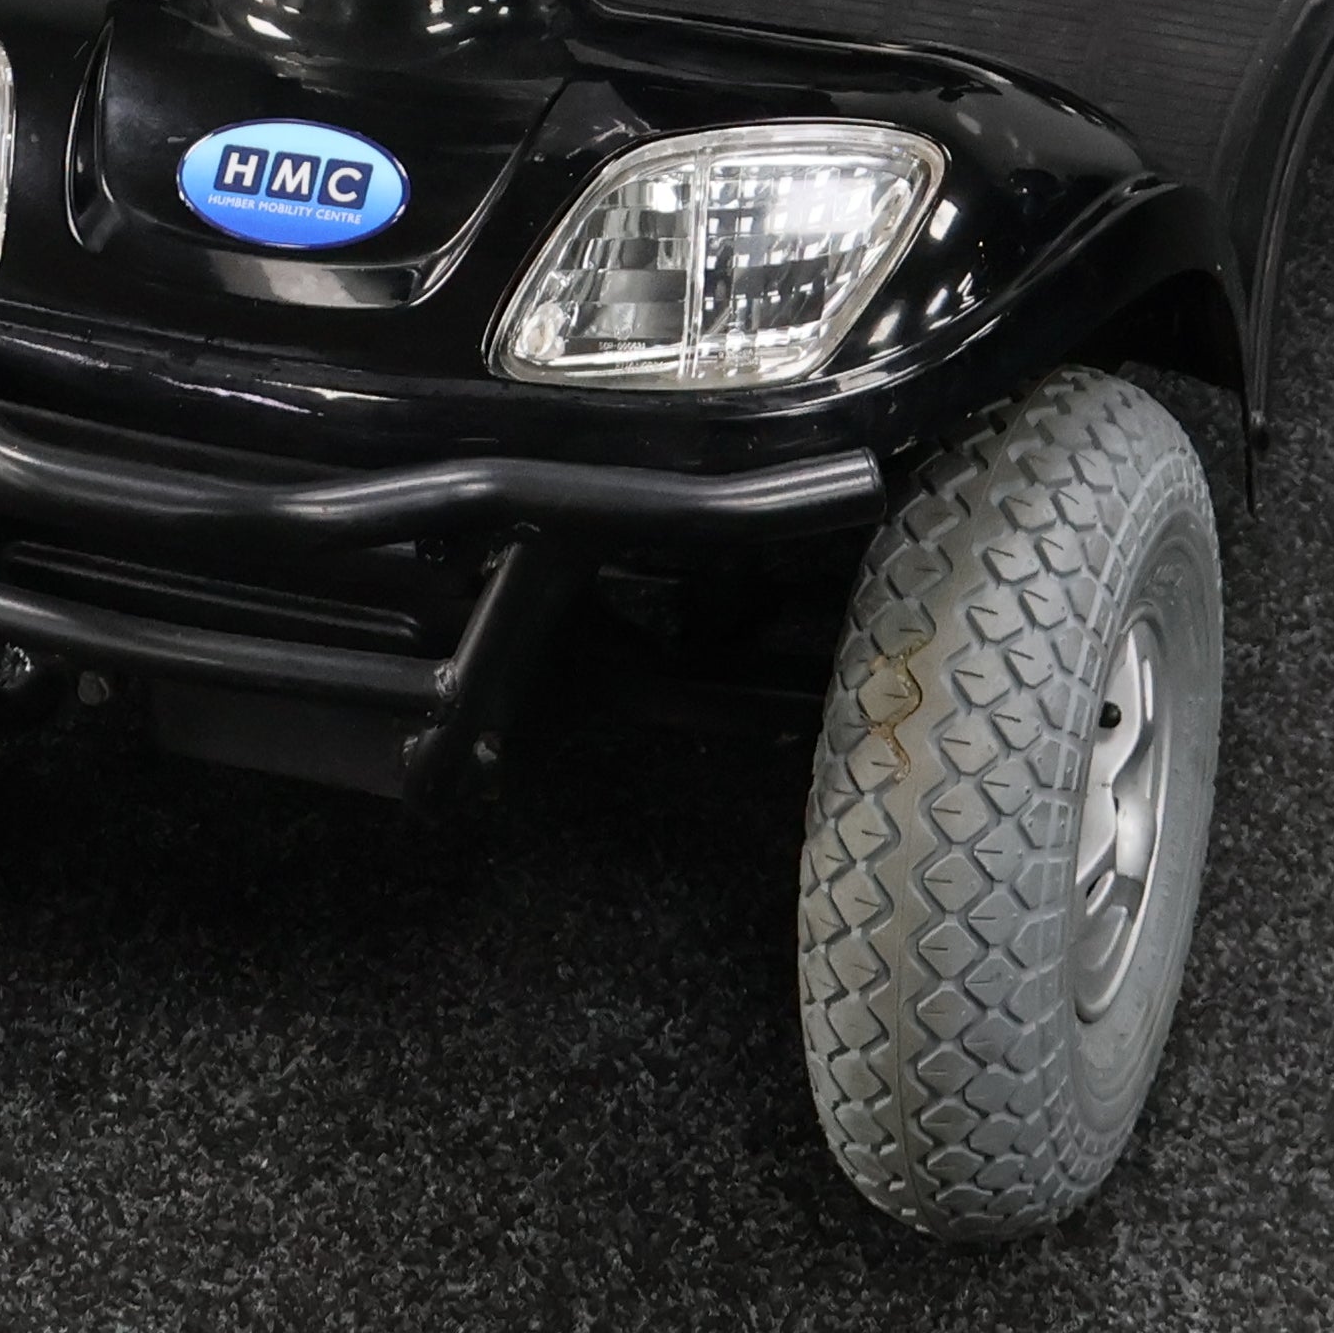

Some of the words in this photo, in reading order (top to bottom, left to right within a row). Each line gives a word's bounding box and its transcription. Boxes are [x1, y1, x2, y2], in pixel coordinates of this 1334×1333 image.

[224, 152, 363, 203] HMC
[208, 194, 255, 210] HUMBER
[258, 201, 314, 218] MOBILITY
[316, 209, 362, 225] CENTRE
